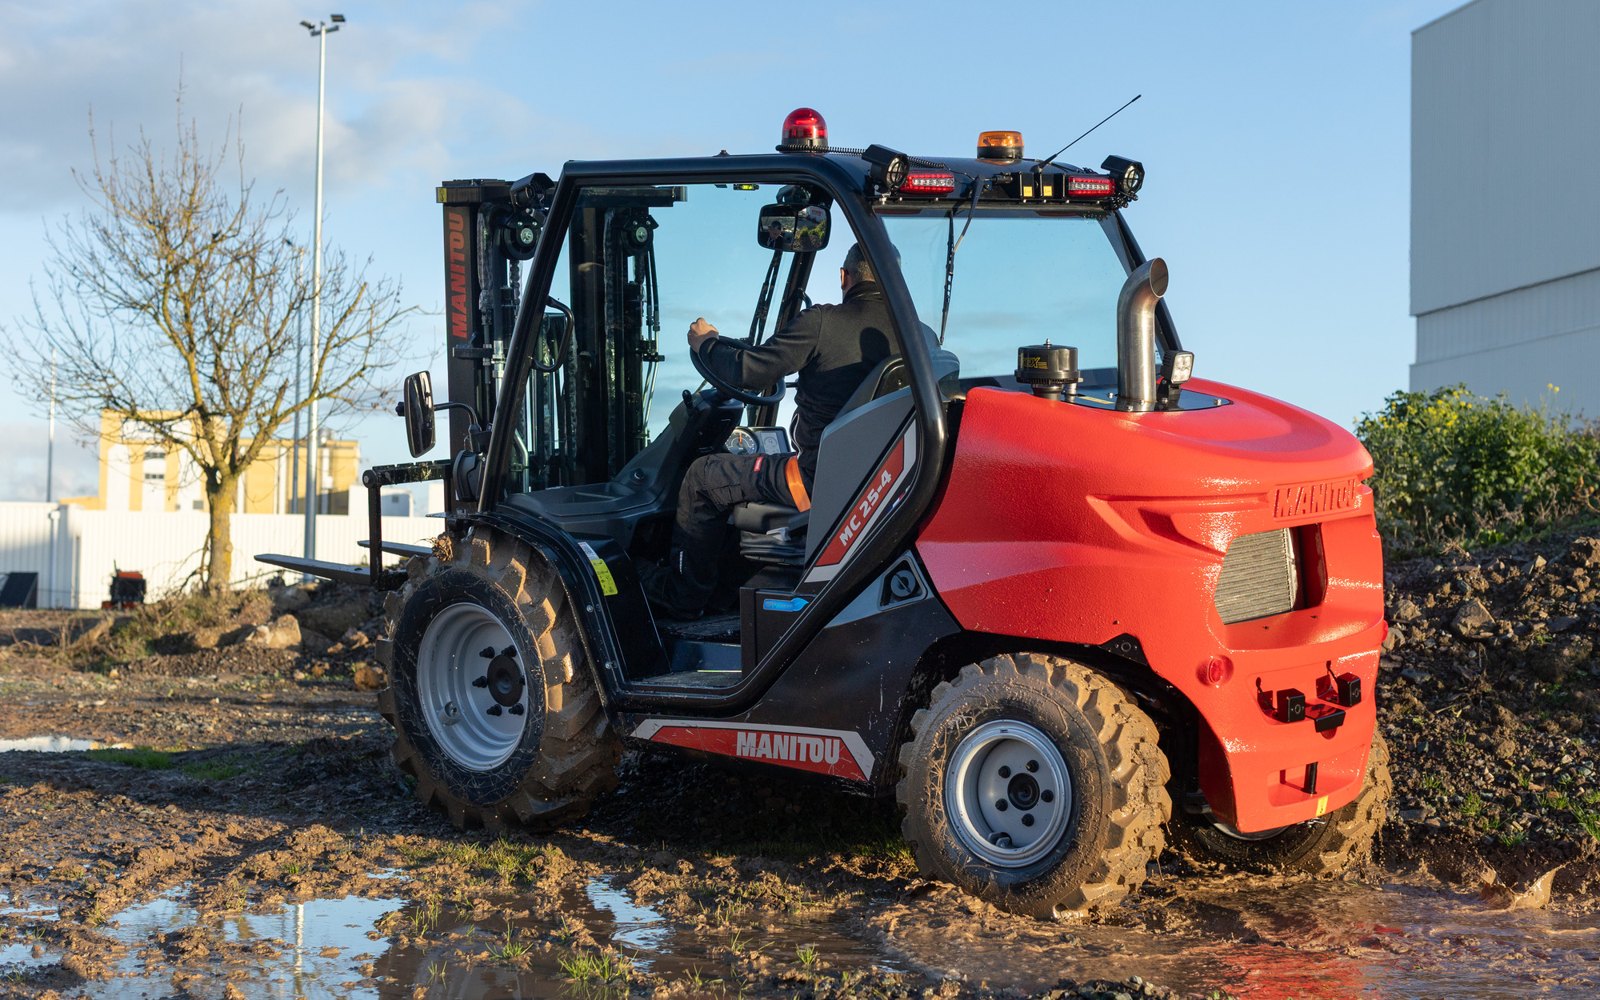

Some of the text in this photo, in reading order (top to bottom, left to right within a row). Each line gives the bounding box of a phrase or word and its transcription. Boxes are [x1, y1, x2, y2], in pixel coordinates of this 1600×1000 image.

[448, 212, 467, 339] MANITOU
[840, 469, 892, 546] MC 25-4
[1273, 478, 1361, 518] MANITOU
[736, 731, 840, 765] MANITOU
